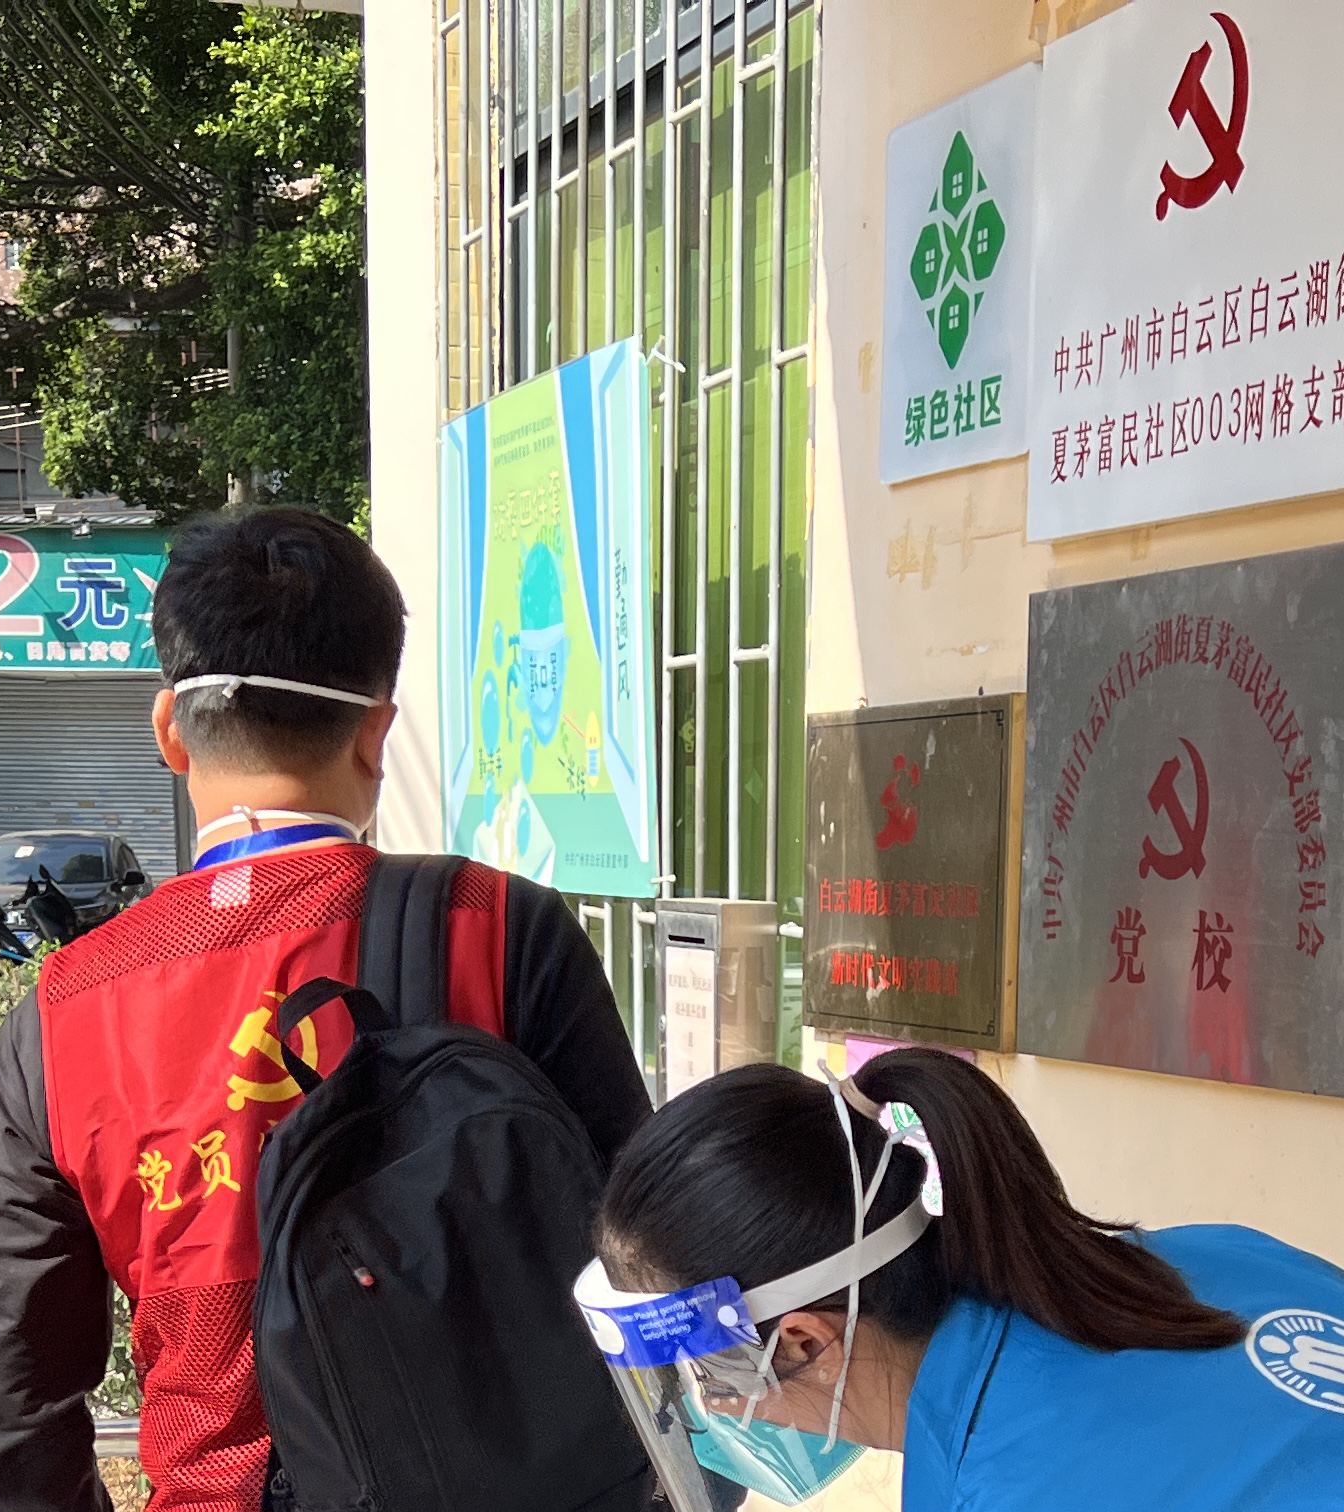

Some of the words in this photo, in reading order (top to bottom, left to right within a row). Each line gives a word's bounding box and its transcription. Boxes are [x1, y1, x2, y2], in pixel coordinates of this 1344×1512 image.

[904, 373, 1005, 448] 绿色社区
[1043, 614, 1326, 959] 中共广州市白云区白云湖街夏茅富民社区支部委员会
[819, 877, 981, 919] 白云湖街夏茅富民社区
[1108, 905, 1235, 996] 党校
[136, 1130, 240, 1212] 党员
